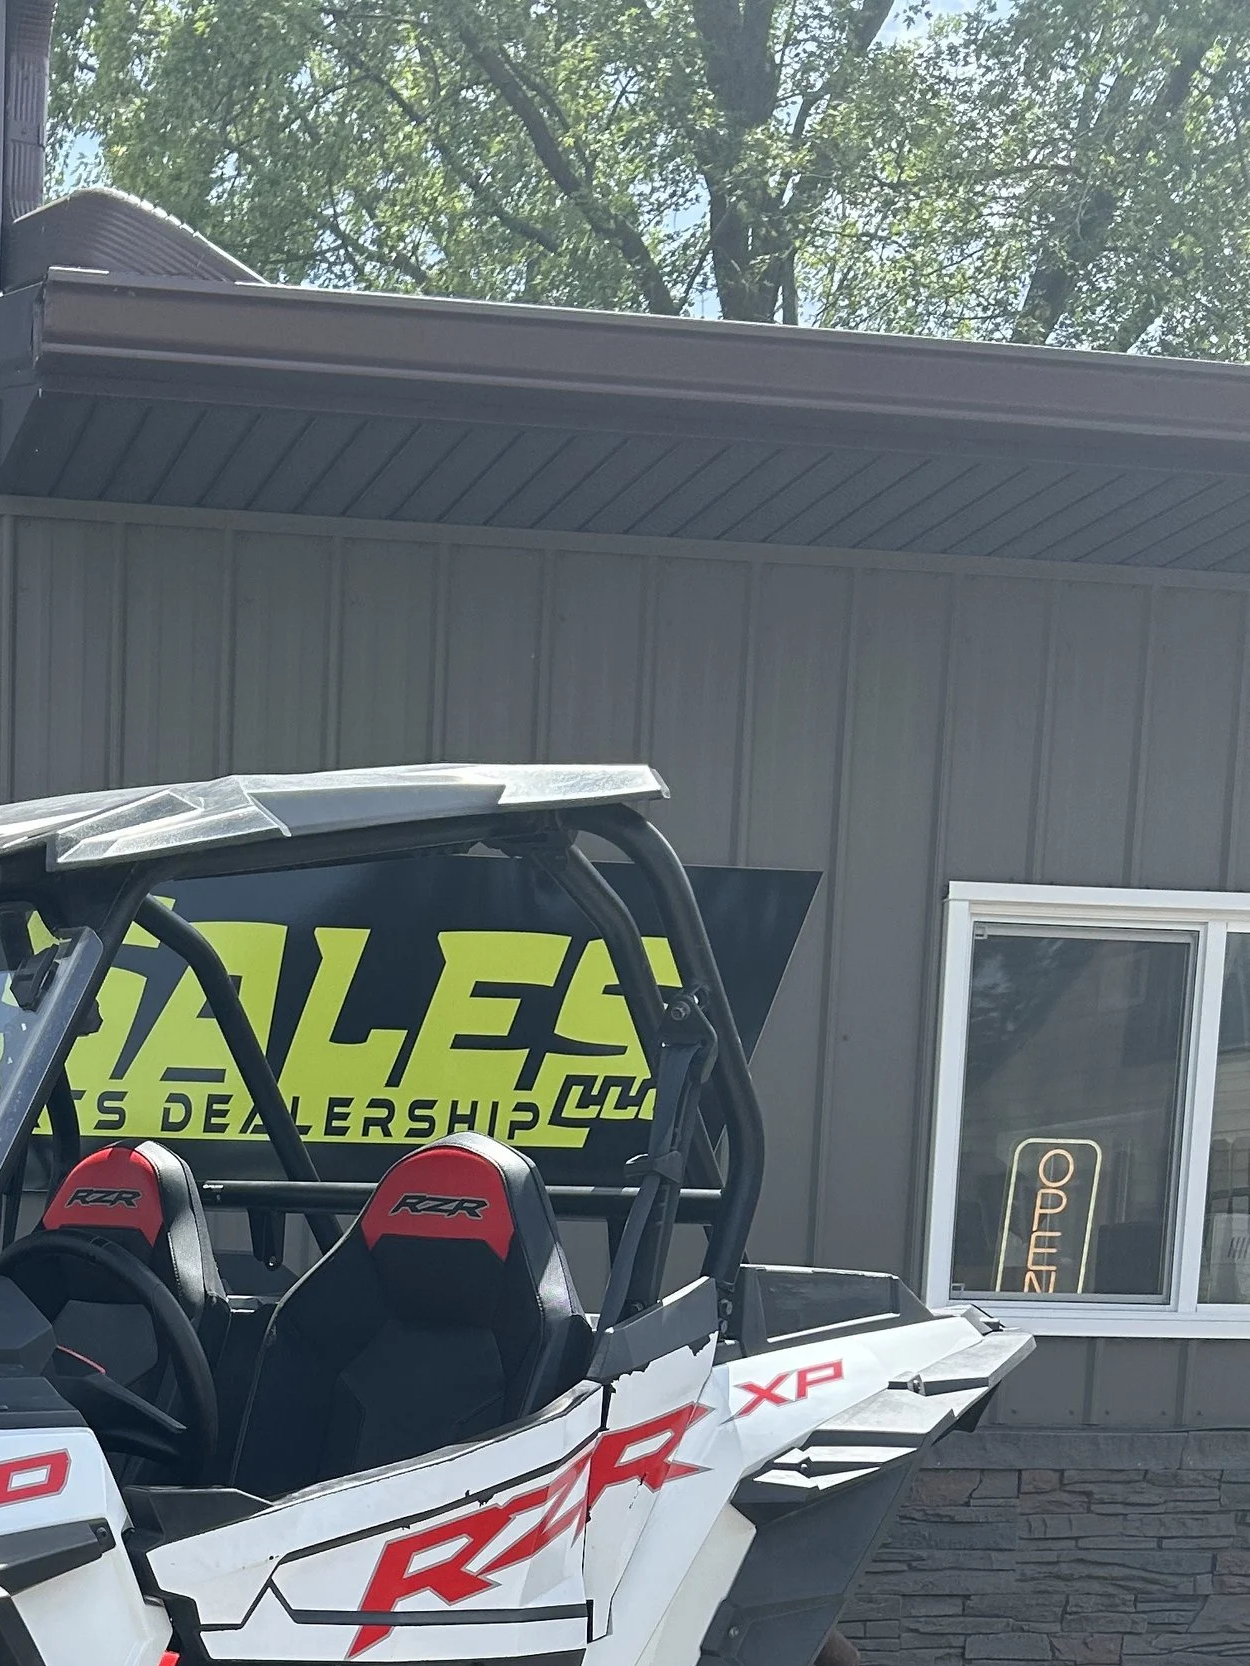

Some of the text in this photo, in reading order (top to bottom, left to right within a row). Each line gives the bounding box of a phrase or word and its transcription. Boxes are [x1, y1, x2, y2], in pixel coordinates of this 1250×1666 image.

[64, 1187, 142, 1208] RZR
[388, 1193, 490, 1219] RZR
[1023, 1149, 1074, 1293] OPEN
[345, 1359, 844, 1660] RZR XP
